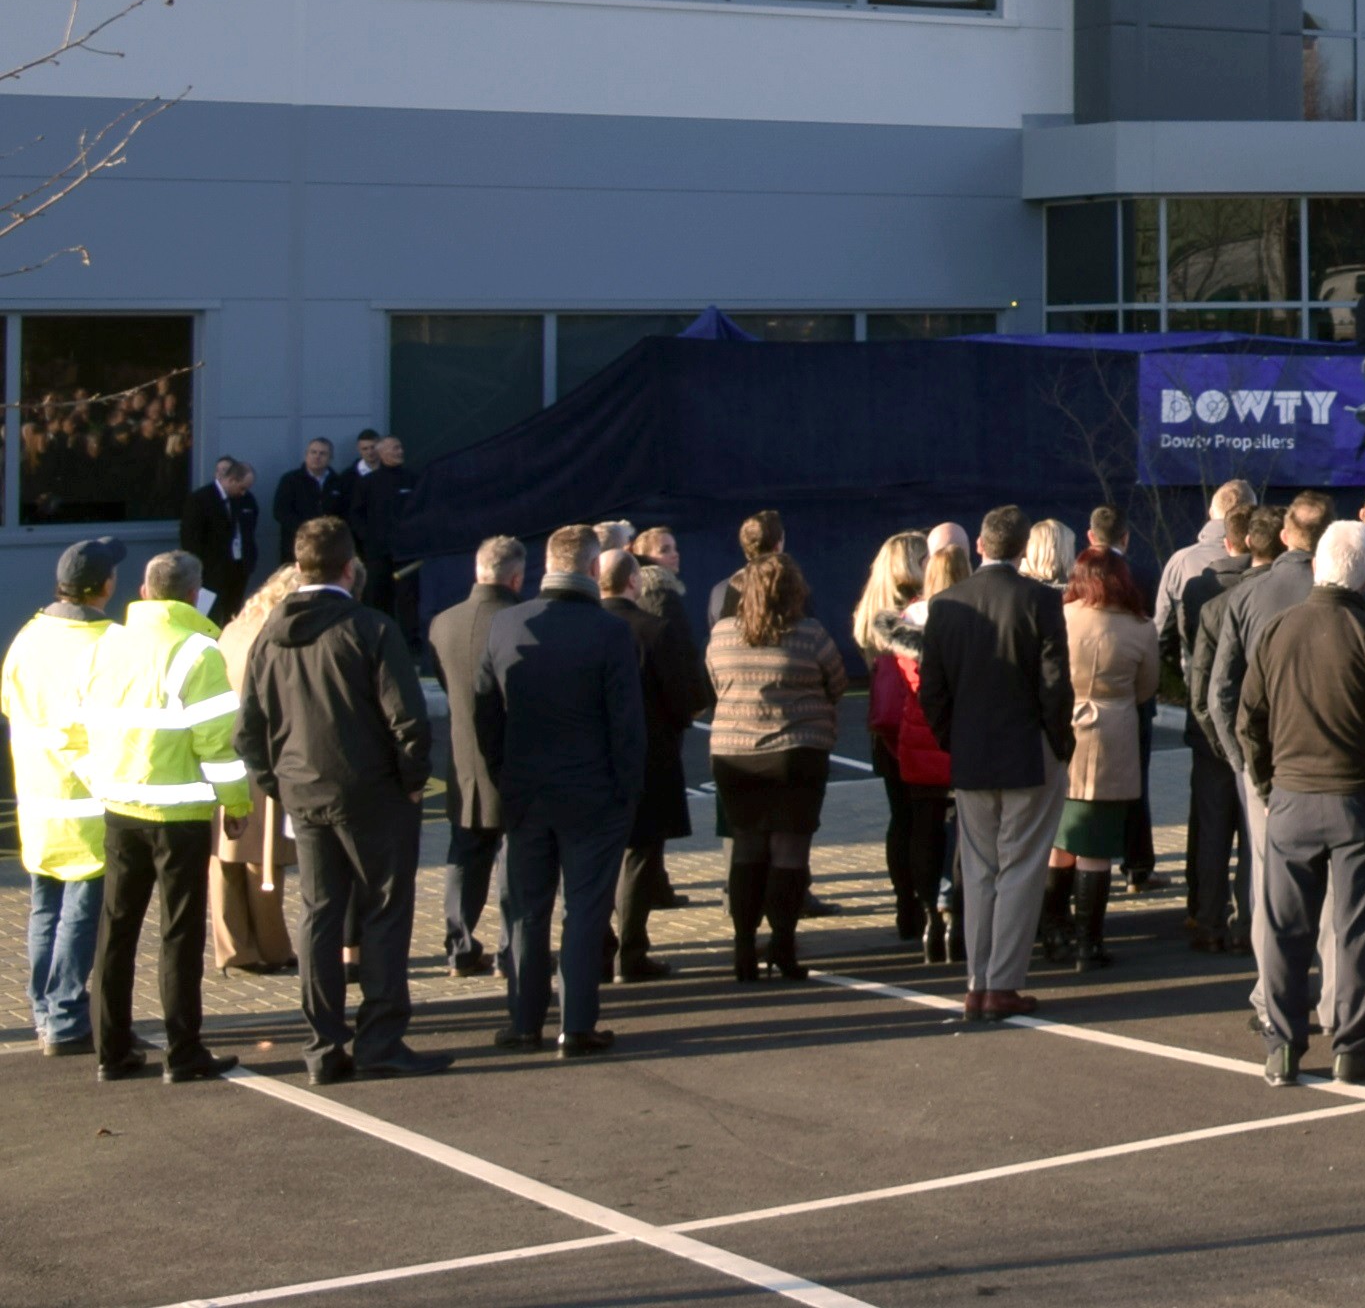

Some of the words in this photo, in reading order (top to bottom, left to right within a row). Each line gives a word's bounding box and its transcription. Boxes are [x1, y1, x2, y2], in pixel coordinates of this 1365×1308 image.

[1161, 389, 1338, 425] DOWTY
[1160, 433, 1212, 452] Dowty
[1214, 433, 1295, 452] Propellers
